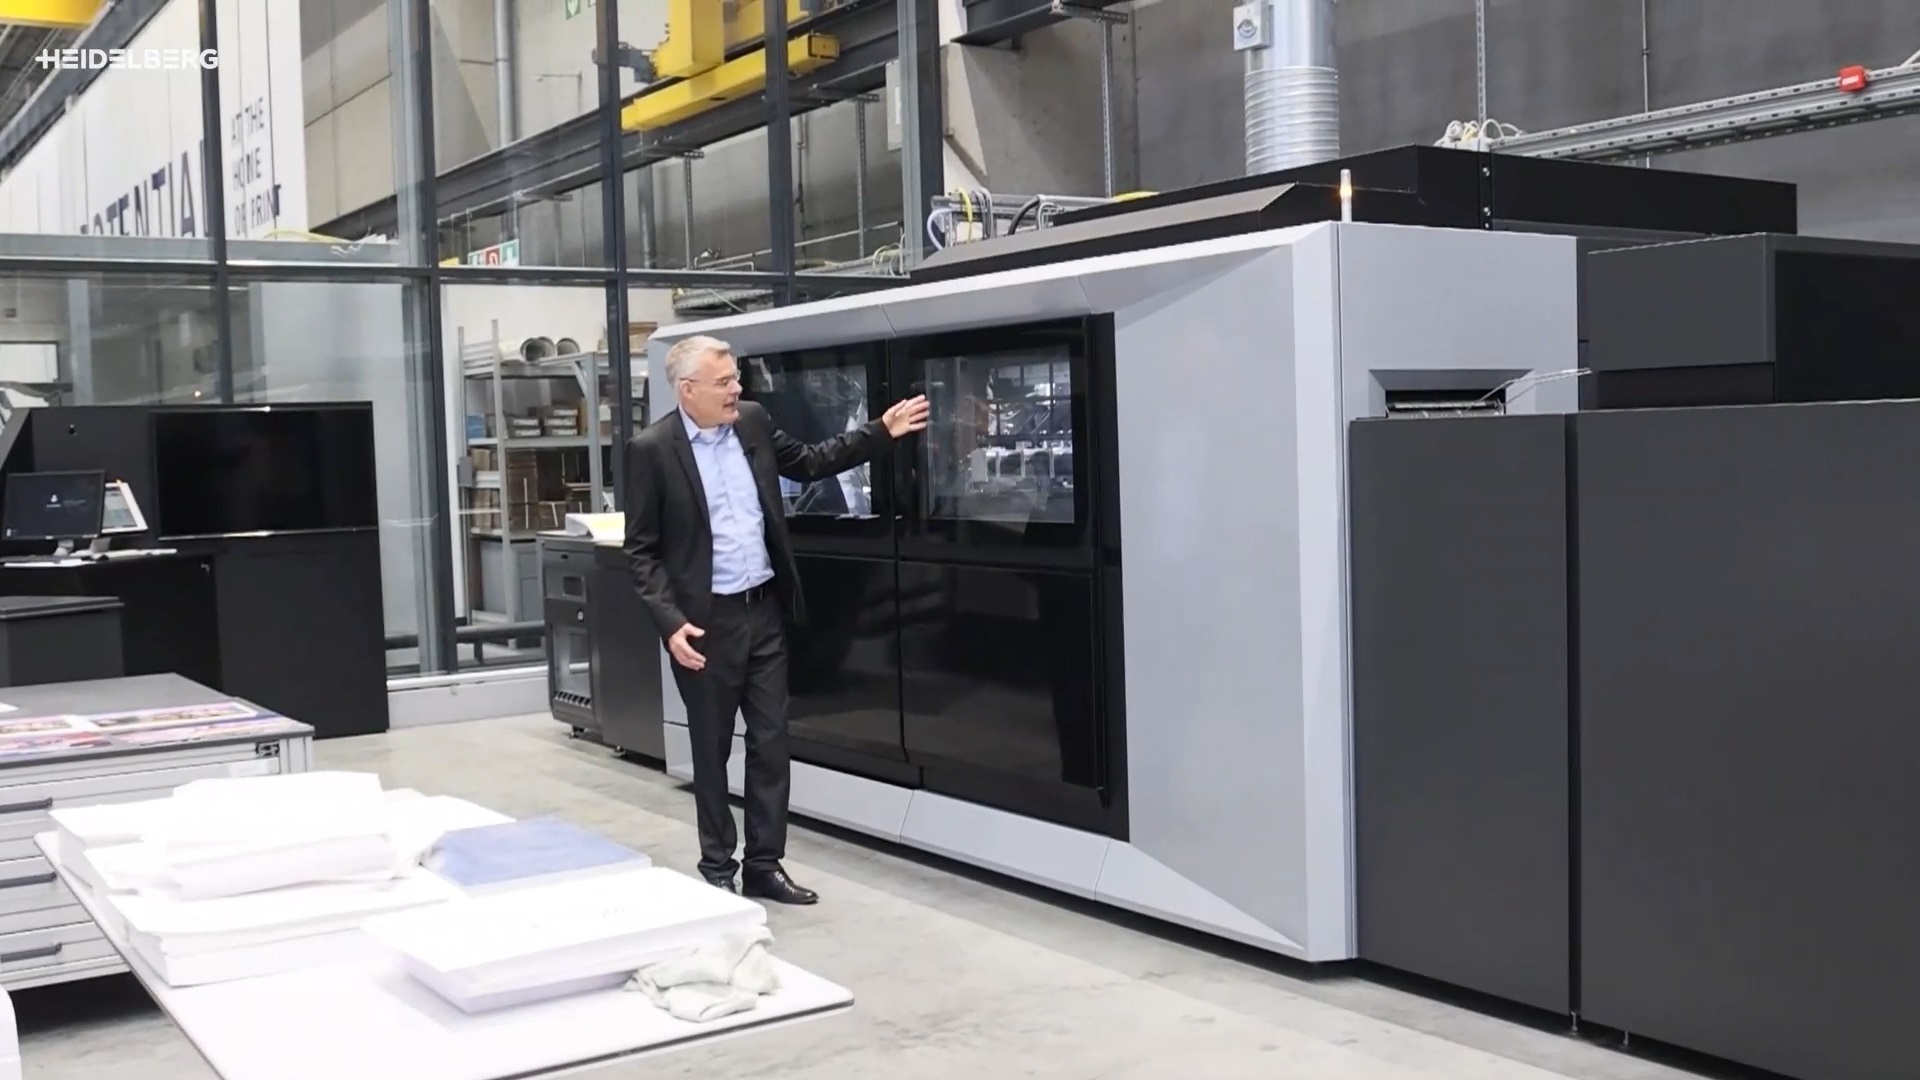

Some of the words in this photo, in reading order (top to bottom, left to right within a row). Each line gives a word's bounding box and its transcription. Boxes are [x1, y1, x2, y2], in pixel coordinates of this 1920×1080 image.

[244, 97, 264, 137] THE
[80, 139, 210, 238] TENTIAL
[232, 147, 262, 191] HOME
[251, 184, 281, 229] PRINT
